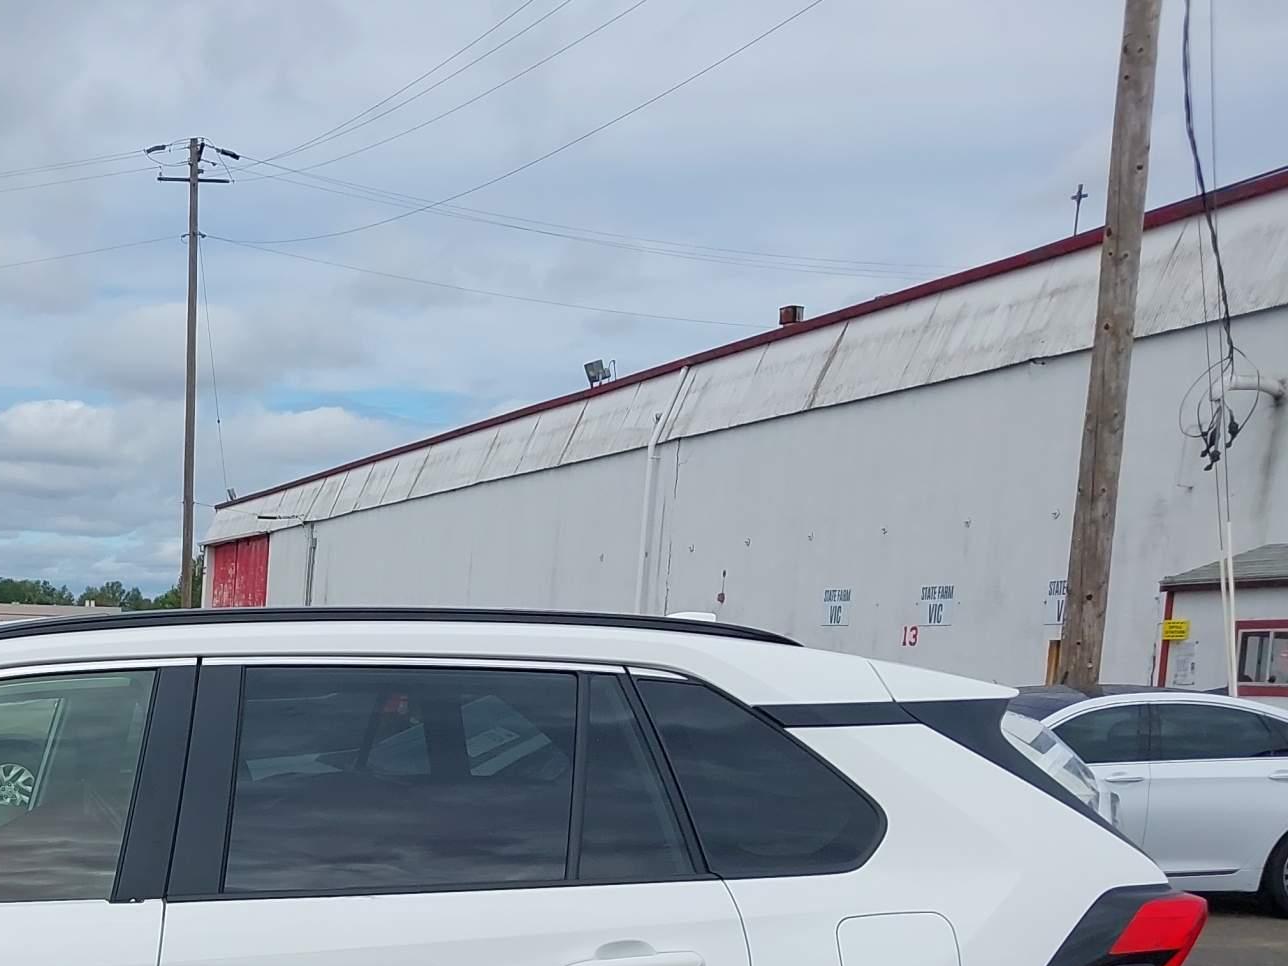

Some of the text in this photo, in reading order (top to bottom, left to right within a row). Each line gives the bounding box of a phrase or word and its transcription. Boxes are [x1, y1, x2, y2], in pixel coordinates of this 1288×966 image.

[824, 589, 851, 602] STATE FARM
[921, 585, 954, 601] STATE FARM
[1049, 580, 1066, 596] STATE
[829, 605, 842, 624] VIC
[928, 603, 943, 624] VIC
[902, 626, 919, 647] 13
